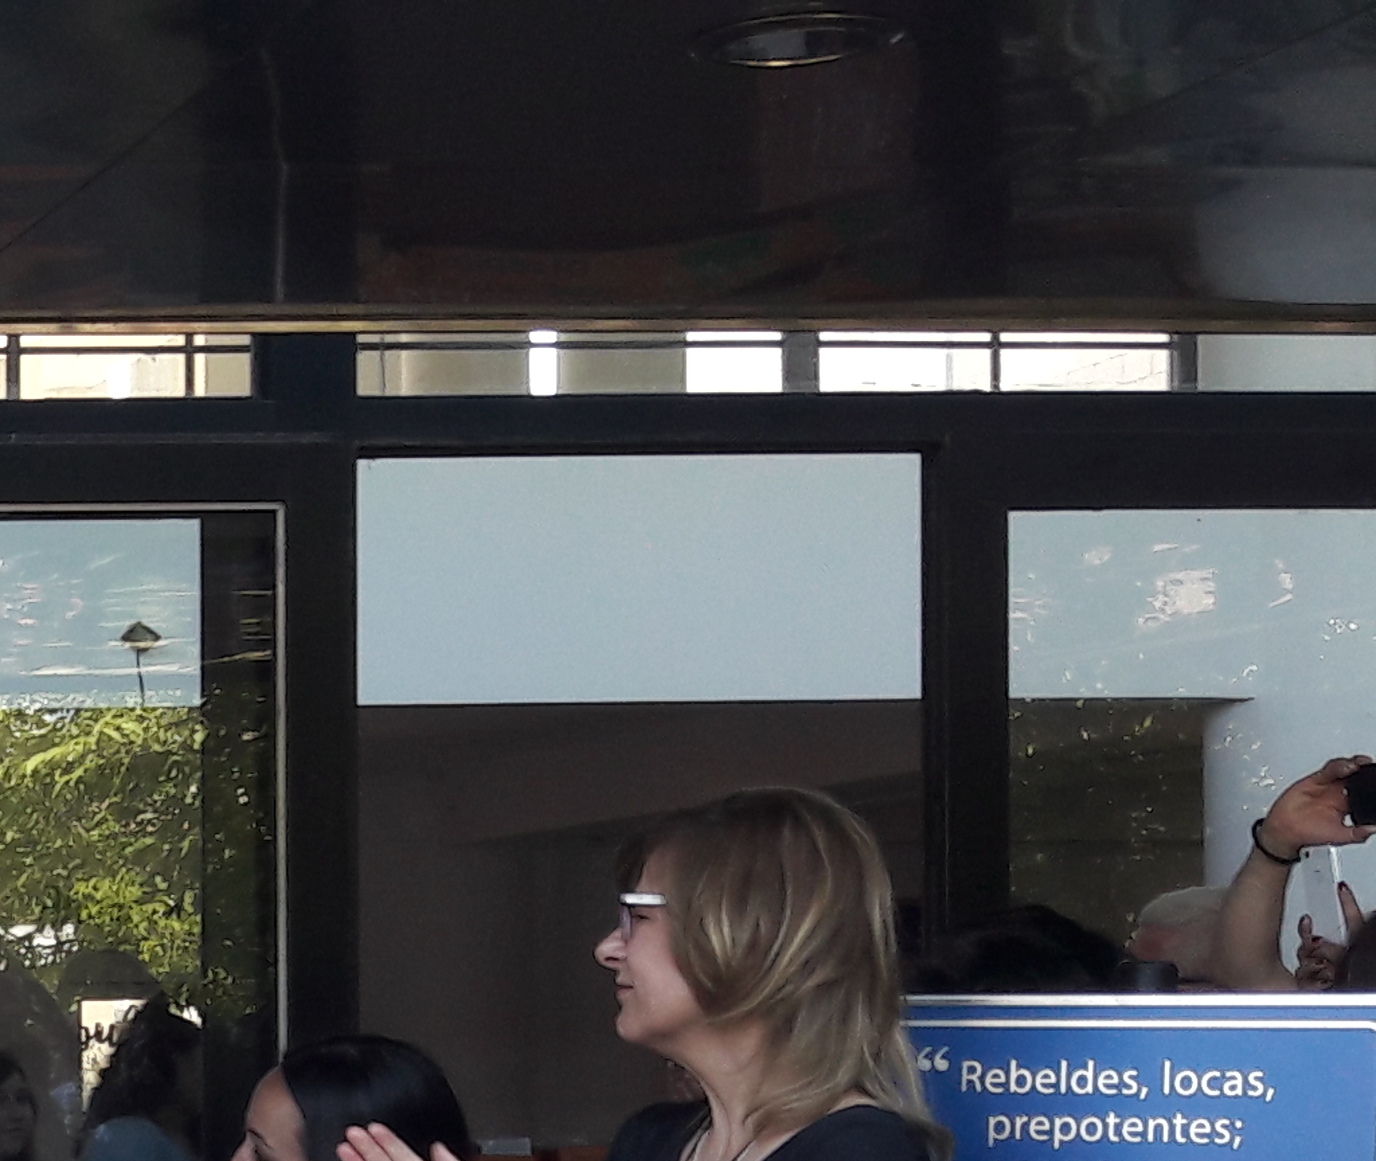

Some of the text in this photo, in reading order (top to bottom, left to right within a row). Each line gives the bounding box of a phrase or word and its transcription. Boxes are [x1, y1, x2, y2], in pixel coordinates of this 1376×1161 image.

[960, 1058, 1149, 1100] Rebeldes,
[1162, 1058, 1276, 1102] locas,
[986, 1110, 1245, 1150] prepotentes;
